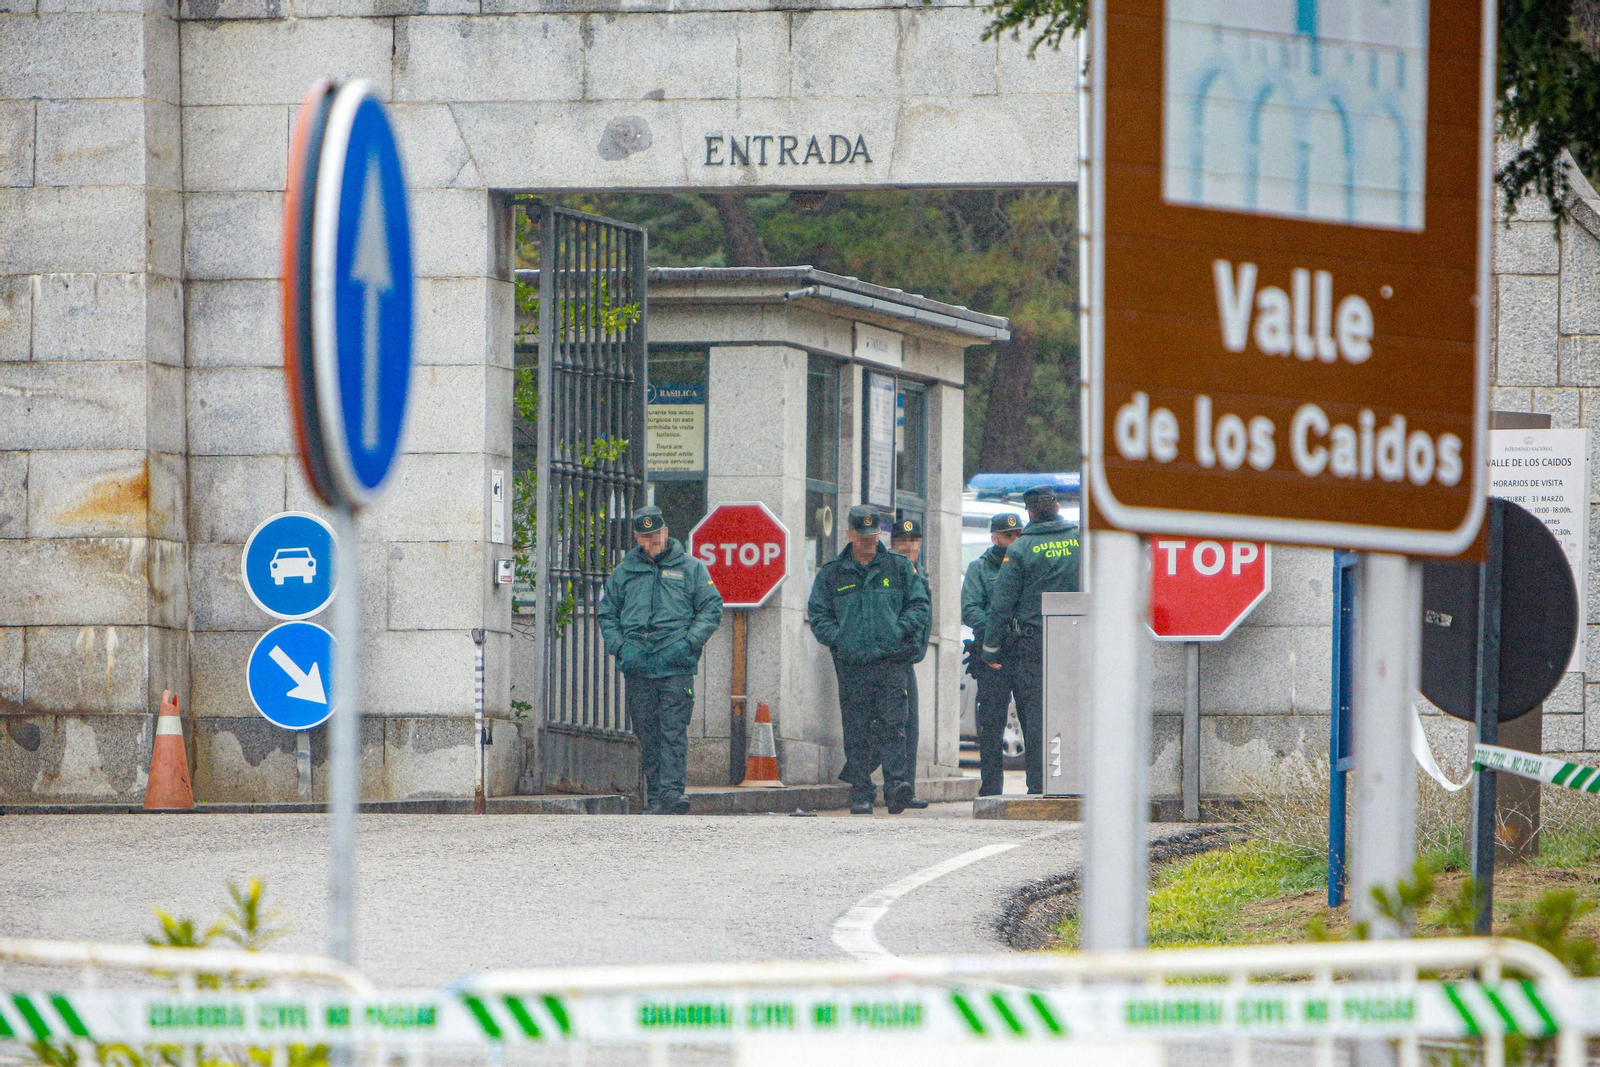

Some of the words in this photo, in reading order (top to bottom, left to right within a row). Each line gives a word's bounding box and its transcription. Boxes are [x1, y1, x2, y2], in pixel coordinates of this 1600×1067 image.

[704, 133, 873, 166] ENTRADA
[1212, 258, 1375, 365] Valle
[1114, 390, 1180, 464] de
[1194, 393, 1277, 472] los
[1290, 403, 1464, 488] Caidos
[1486, 459, 1510, 467] VALLE
[1512, 459, 1523, 467] DE
[1525, 458, 1540, 467] LOS
[1542, 458, 1572, 467] CAIDOS
[699, 543, 781, 567] STOP
[1033, 538, 1079, 553] GUARDIA
[1046, 548, 1072, 558] CIVIL
[1146, 540, 1259, 576] TOP
